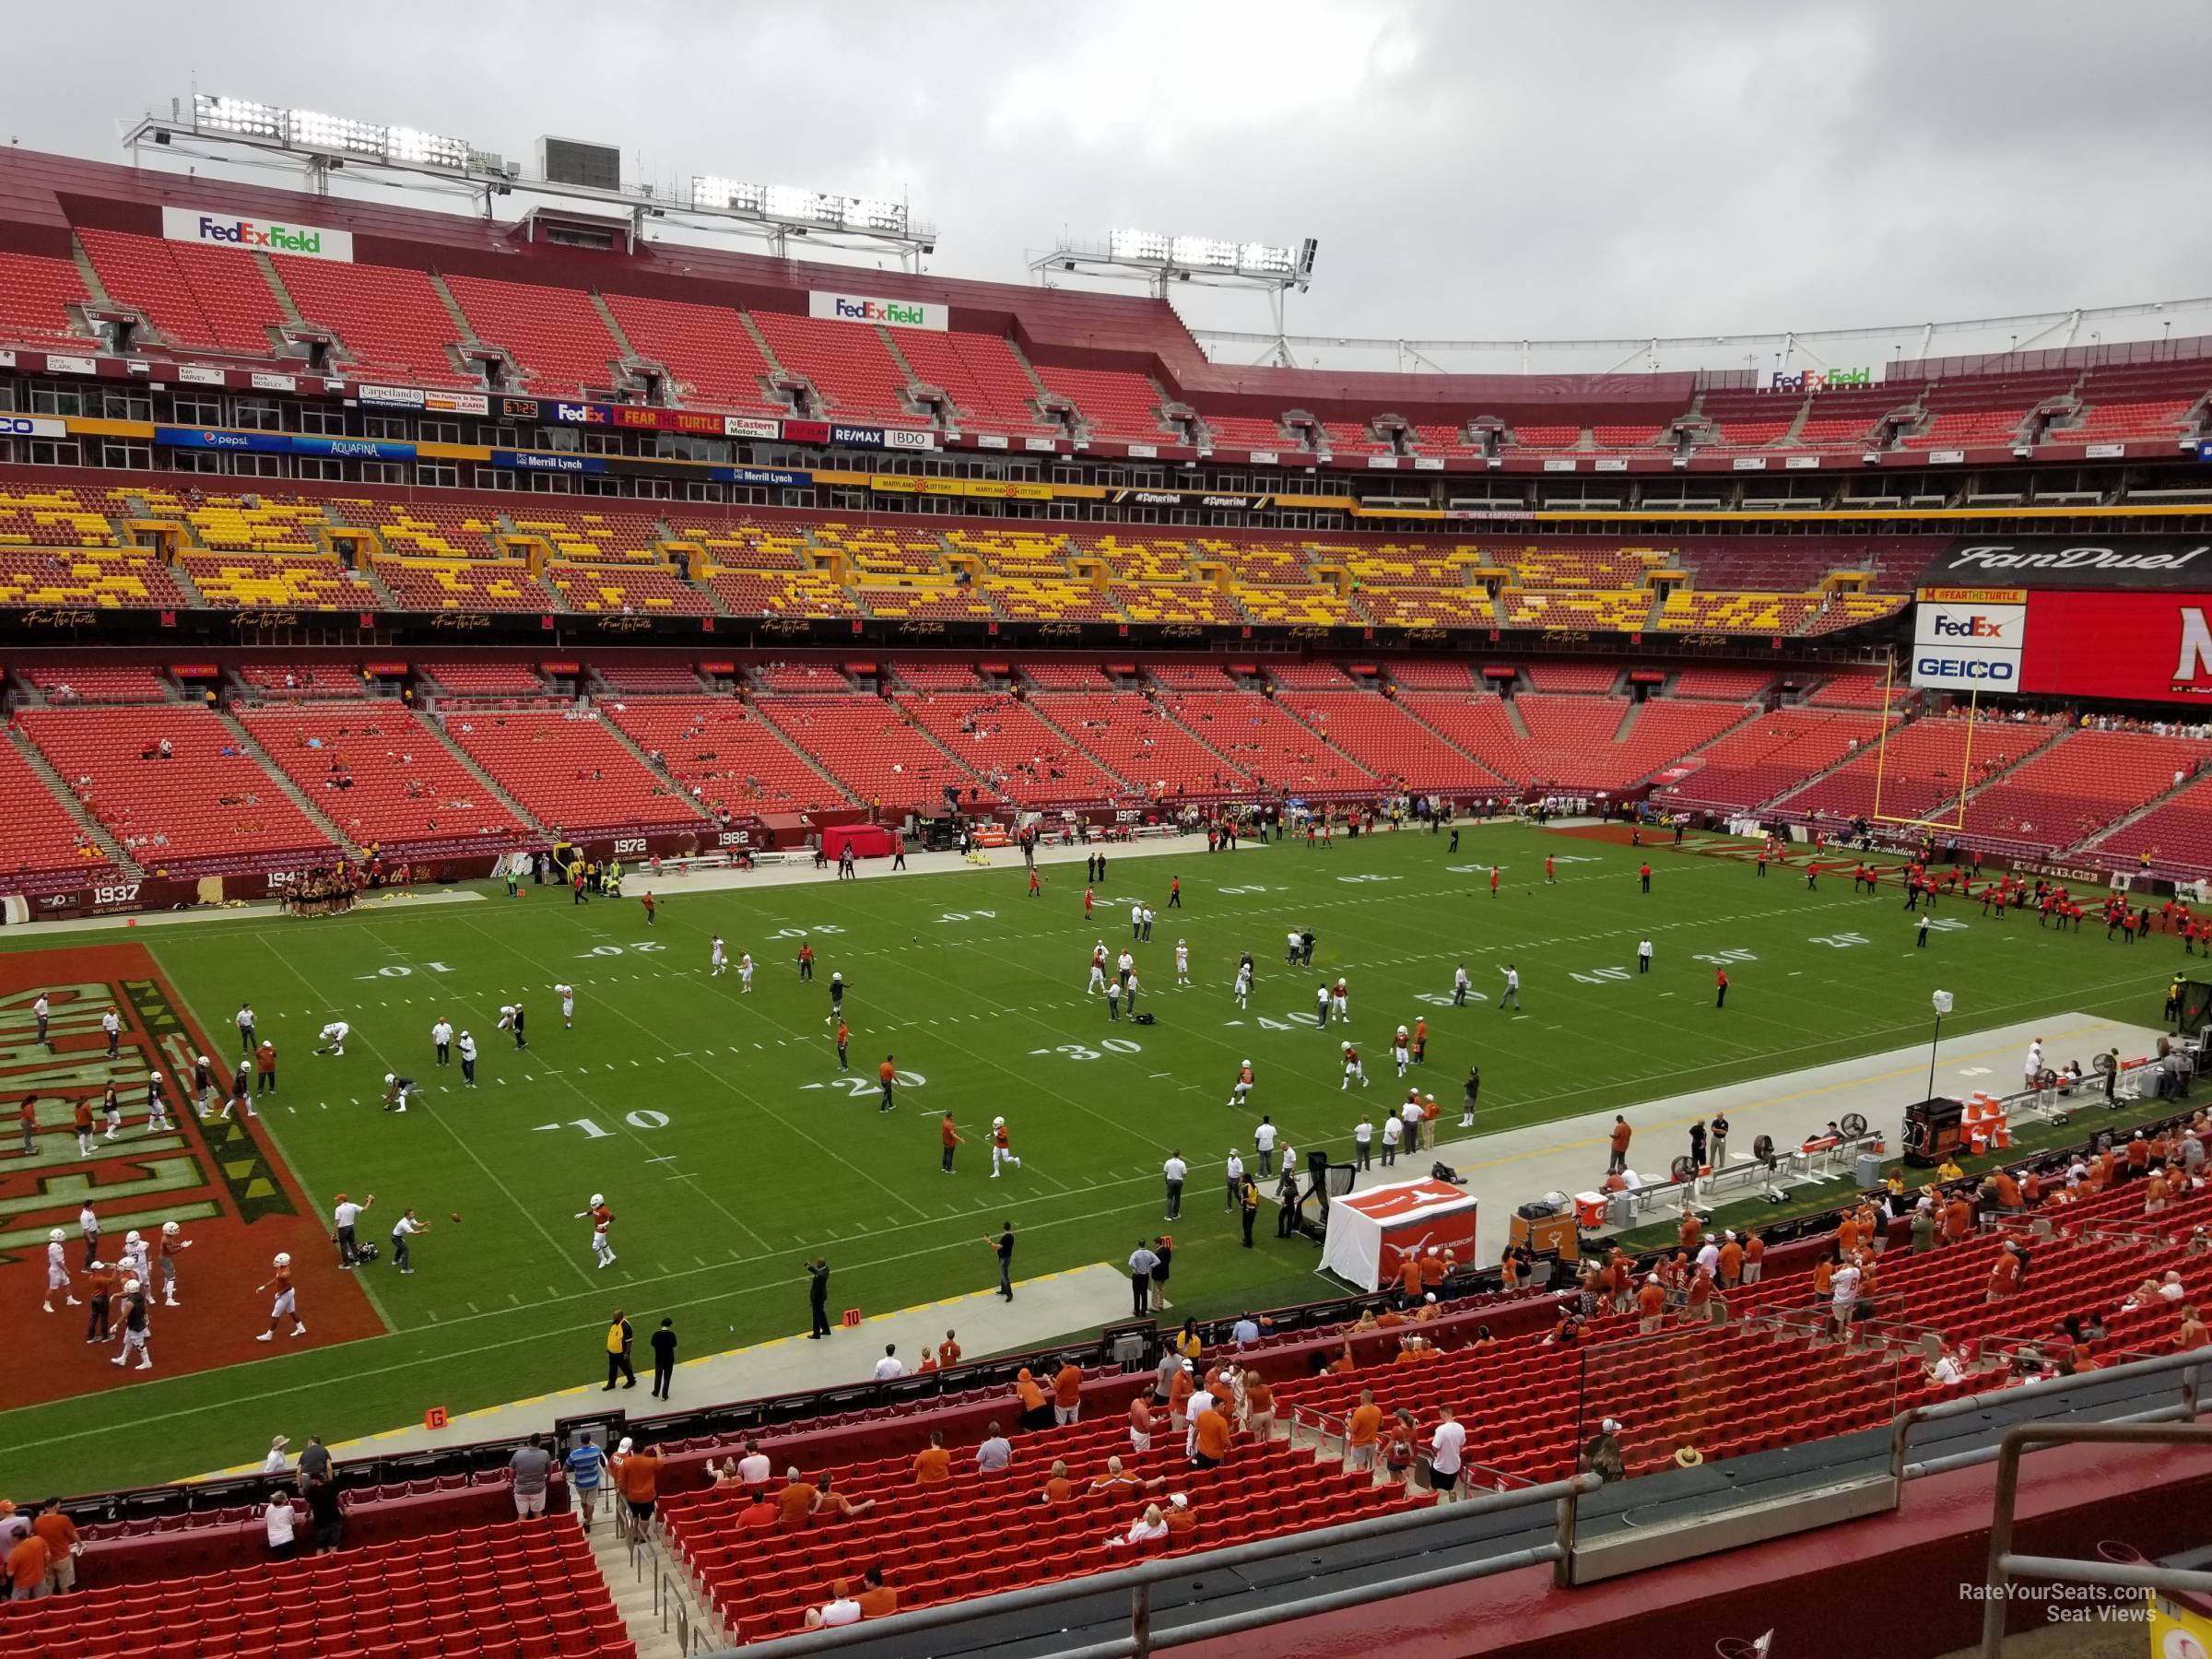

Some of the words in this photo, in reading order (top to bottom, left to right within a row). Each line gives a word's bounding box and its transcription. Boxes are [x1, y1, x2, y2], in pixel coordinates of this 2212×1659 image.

[361, 384, 413, 401] Carpetland
[427, 400, 456, 409] Support
[457, 401, 486, 409] LEARN
[504, 401, 536, 415] 67:25
[559, 404, 605, 423] FedEx
[736, 418, 775, 431] Eastern
[218, 435, 248, 446] pepsi
[835, 429, 881, 443] RE/MAX
[897, 431, 925, 444] BDO
[331, 441, 380, 457] AQUAFINA
[528, 455, 557, 467] Merrill
[558, 457, 582, 469] Lynch
[745, 471, 771, 482] Merrill
[771, 473, 793, 484] Lynch
[882, 479, 914, 488] MARYLAND
[926, 483, 952, 491] LOTTERY
[975, 486, 1006, 494] MARYLAND
[1017, 488, 1041, 496] LOTTERY
[1948, 547, 2210, 570] FanDuel
[1935, 615, 2004, 639] FedEx
[1917, 658, 2014, 680] GEICO
[614, 838, 647, 853] 1972
[718, 830, 748, 846] 1982
[93, 885, 140, 904] 1937
[1413, 989, 1490, 1006] 50
[1257, 1012, 1320, 1030] 40
[1056, 1039, 1142, 1061] 30
[831, 1070, 926, 1098] 20
[568, 1109, 671, 1139] 10
[1594, 1206, 1605, 1219] G
[2010, 1265, 2019, 1280] 6
[1849, 1277, 1857, 1291] 8
[846, 1310, 861, 1327] 10
[431, 1410, 444, 1427] G
